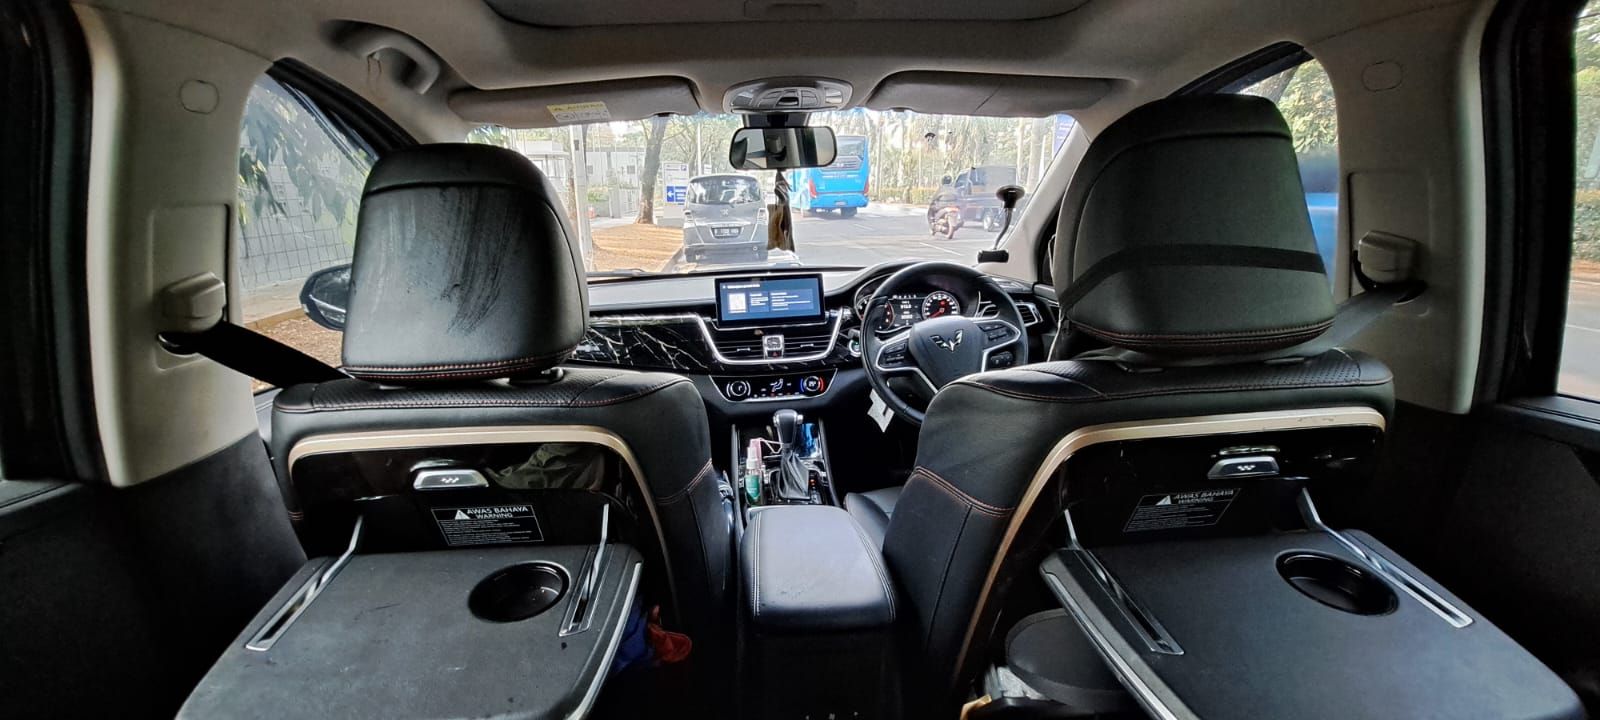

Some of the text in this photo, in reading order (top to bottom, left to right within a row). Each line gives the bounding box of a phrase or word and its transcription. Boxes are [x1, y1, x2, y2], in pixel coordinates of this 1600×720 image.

[1173, 489, 1234, 500] AWAS BAHAYA
[1178, 496, 1214, 504] WARNING
[494, 505, 529, 513] BAHAYA
[475, 512, 513, 520] WARNING
